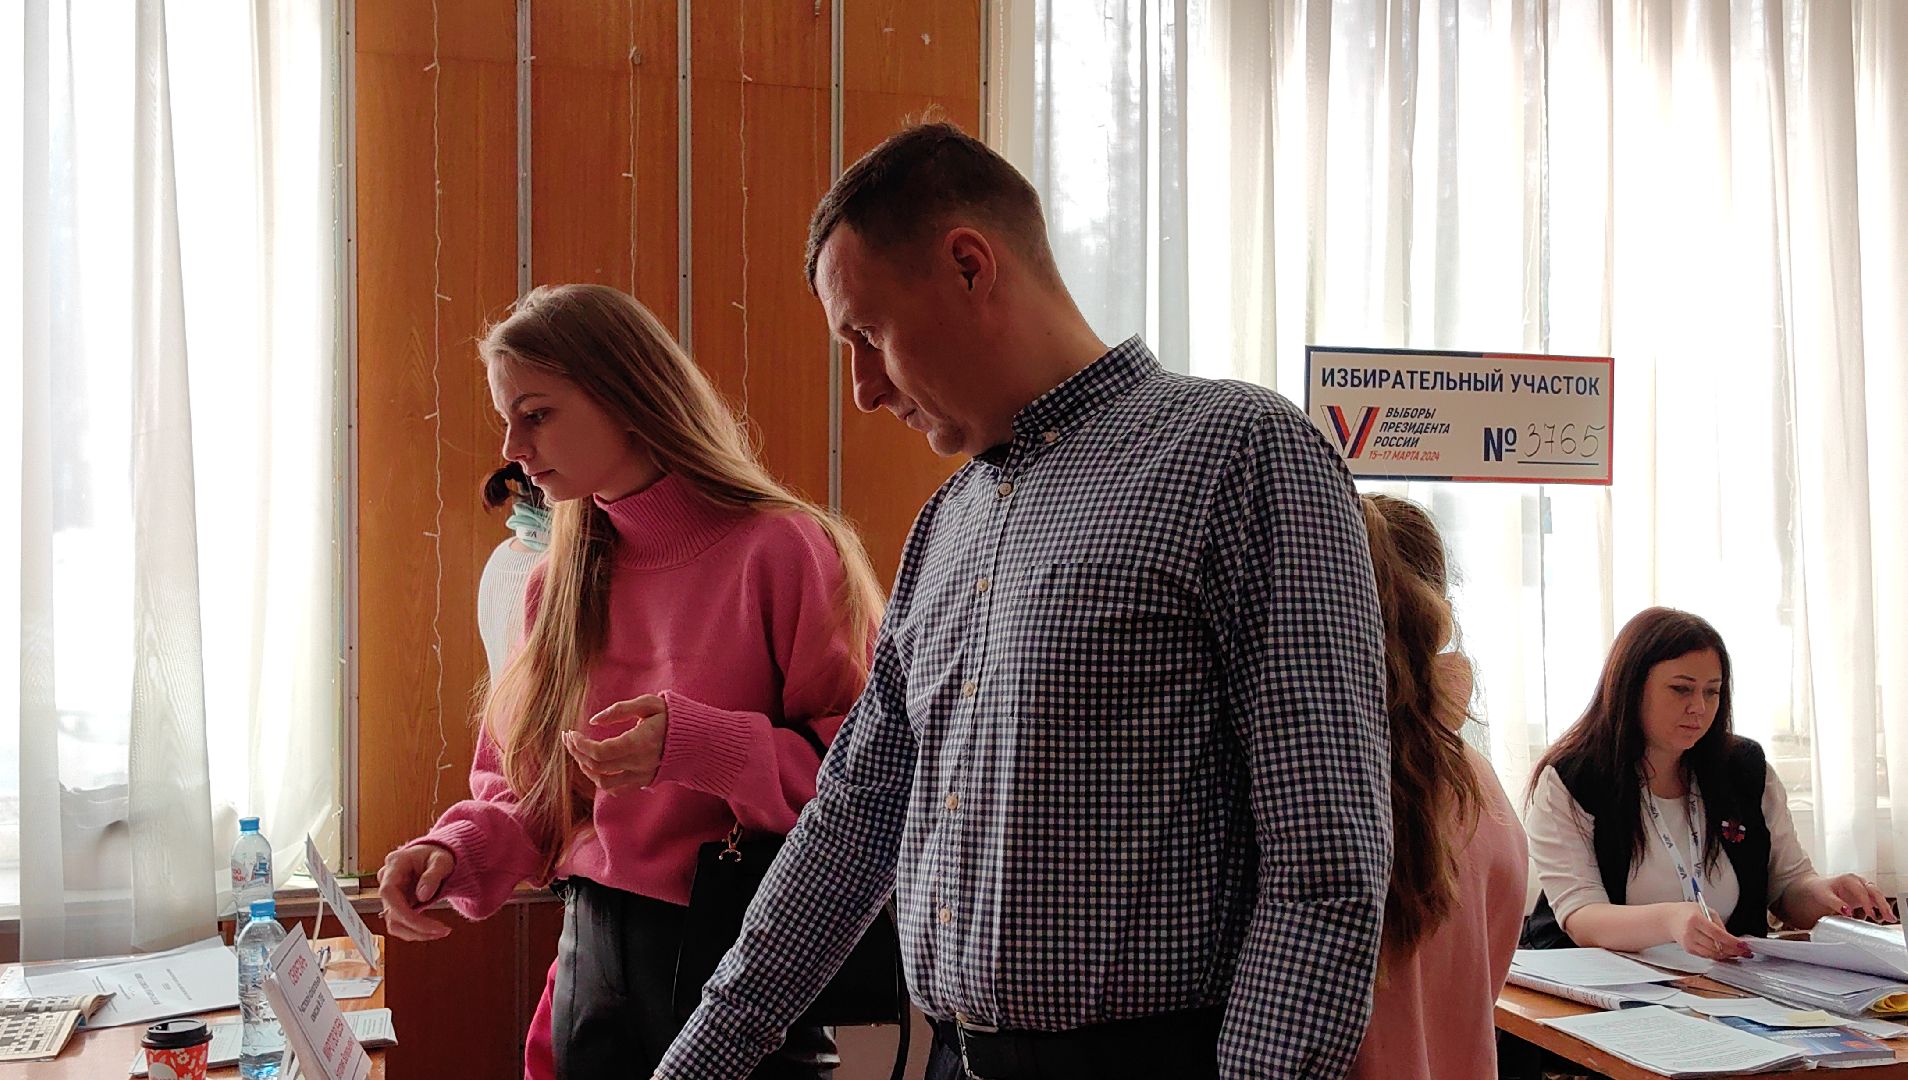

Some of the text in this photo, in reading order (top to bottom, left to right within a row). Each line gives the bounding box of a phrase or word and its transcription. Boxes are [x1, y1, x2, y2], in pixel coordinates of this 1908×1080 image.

[1321, 367, 1601, 396] ИЗБИРАТЕЛЬНЫЙ УЧАСТОК
[1385, 407, 1437, 420] ВЫБОРЫ
[1379, 422, 1451, 435] ПРЕЗИДЕНТА
[1373, 436, 1420, 448] РОССИИ
[1524, 423, 1606, 458] 3765
[1391, 451, 1419, 461] МАРТА
[1420, 452, 1440, 462] 2024
